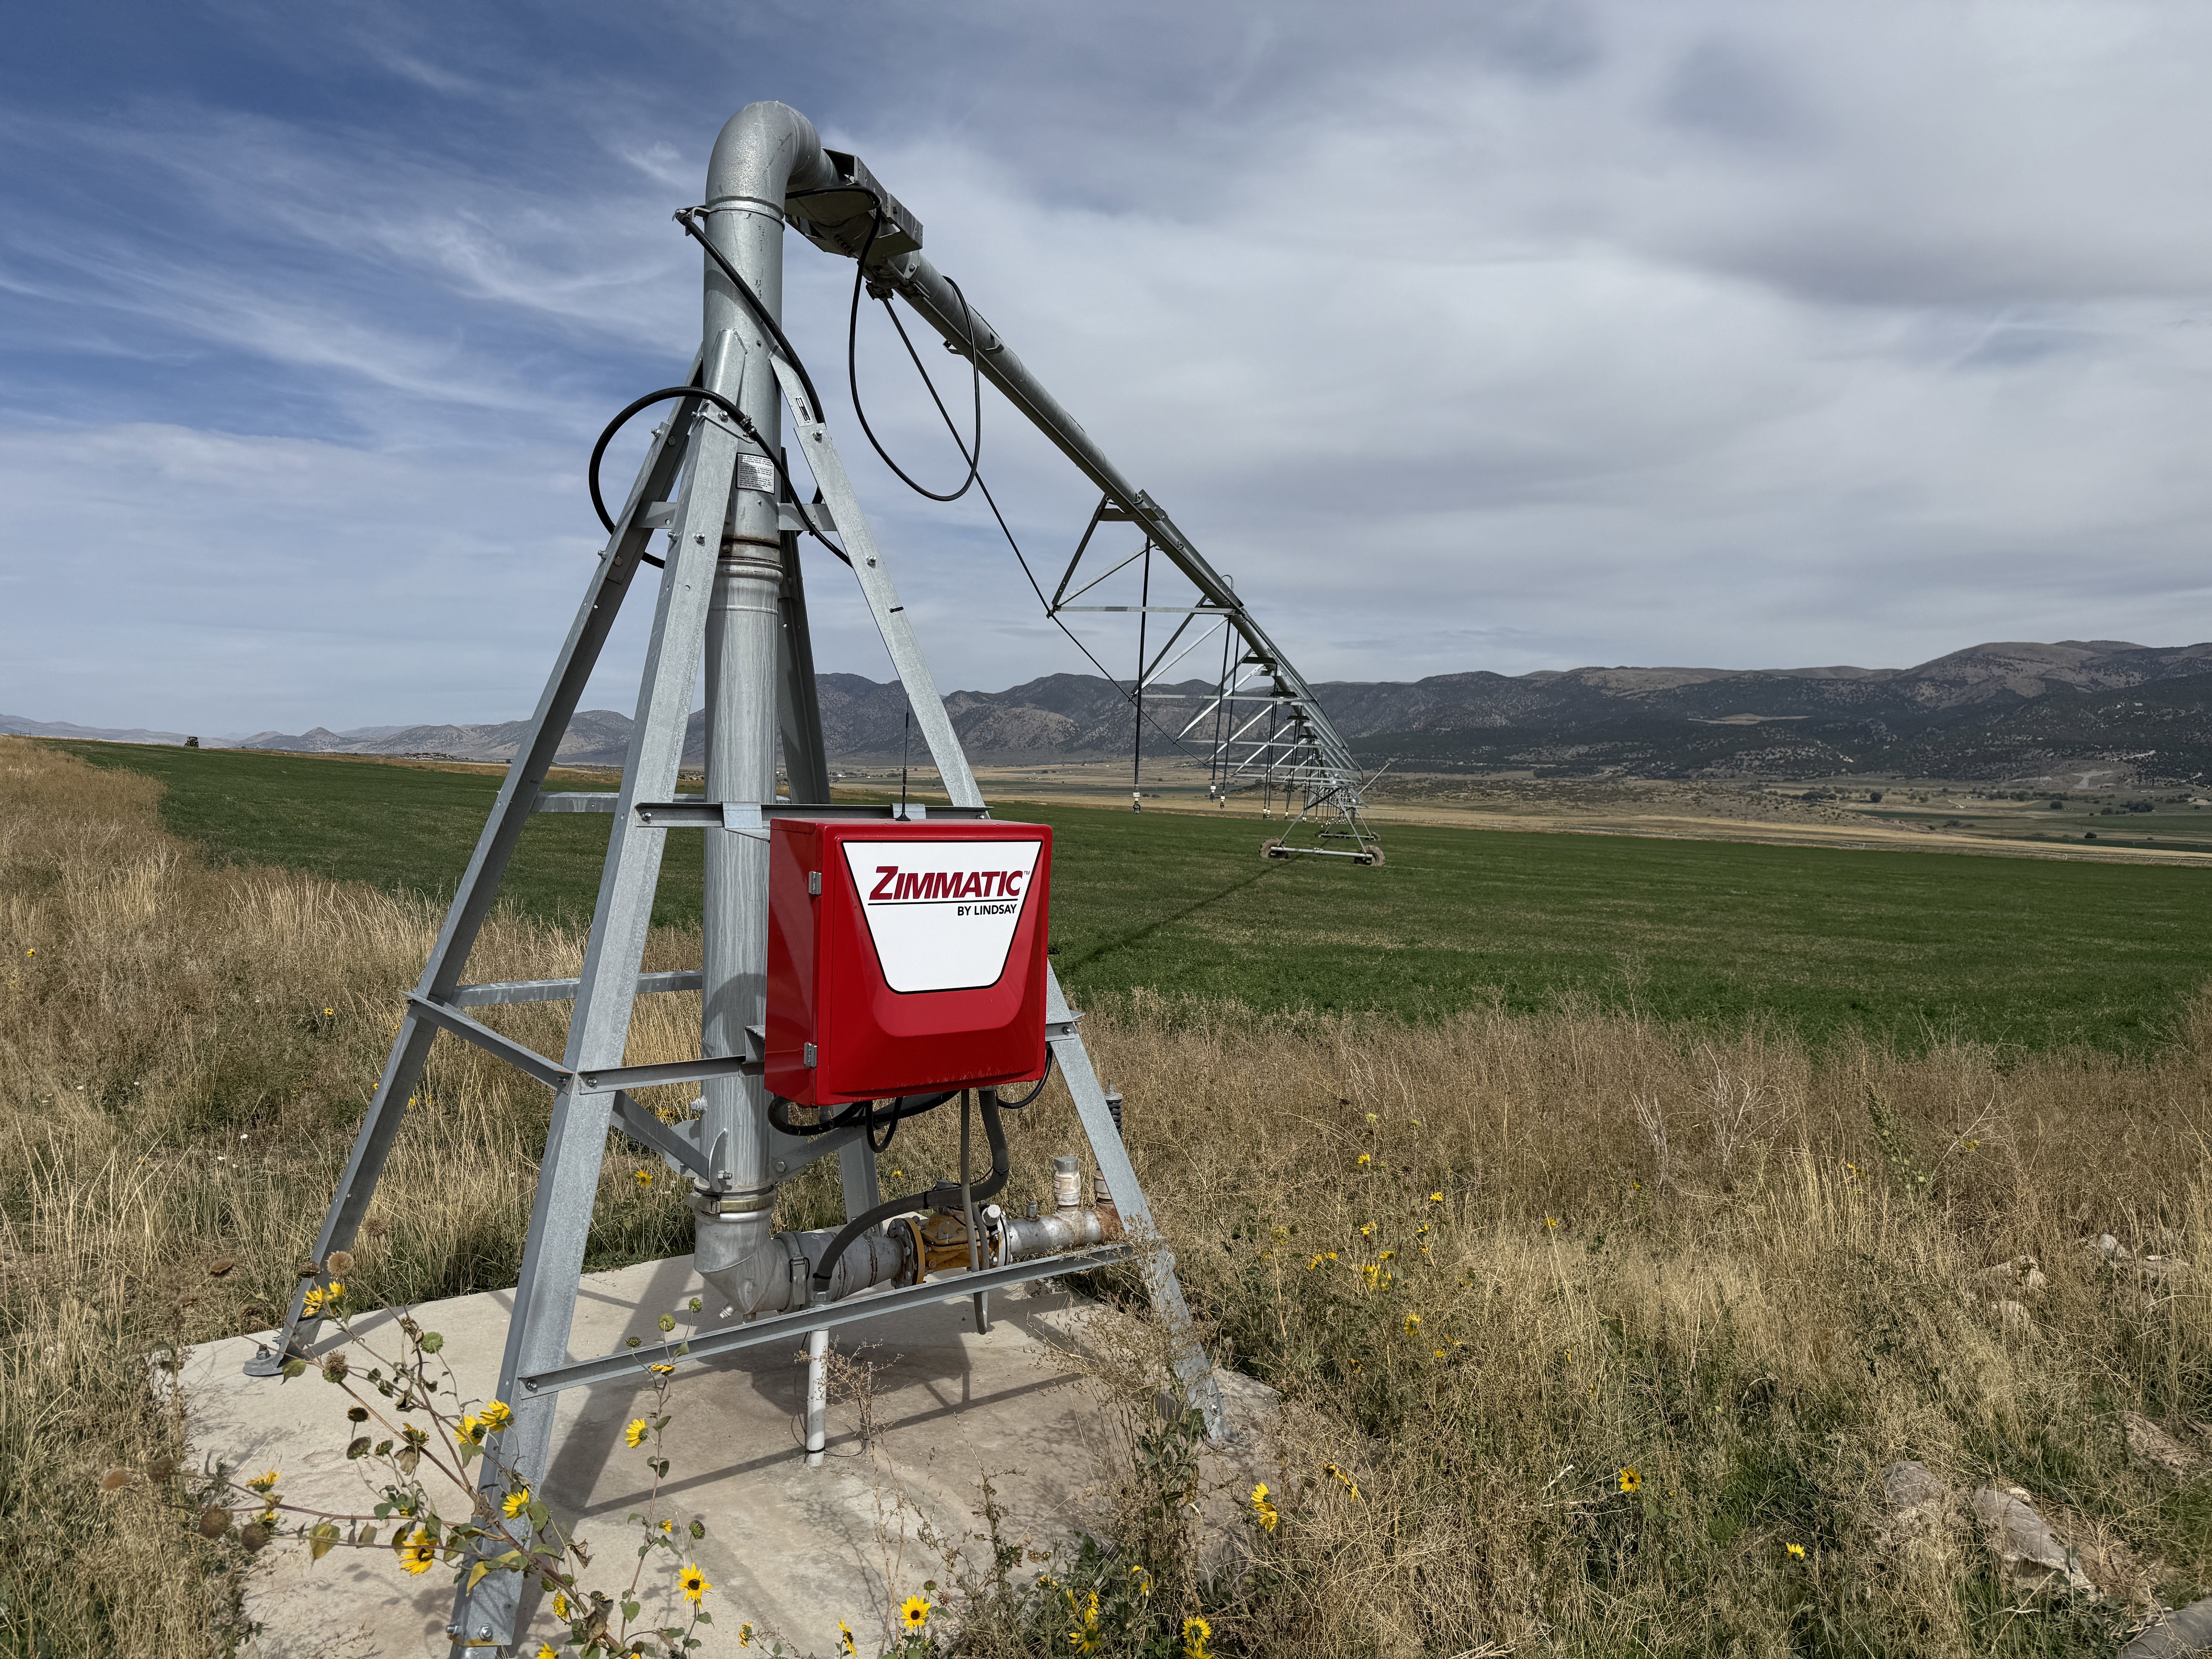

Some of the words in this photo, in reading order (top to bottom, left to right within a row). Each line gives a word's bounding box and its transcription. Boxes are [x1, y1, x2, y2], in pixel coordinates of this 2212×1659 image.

[869, 866, 1023, 900] ZIMMATIC
[958, 906, 971, 916] BY
[974, 904, 1017, 915] LINDSAY
